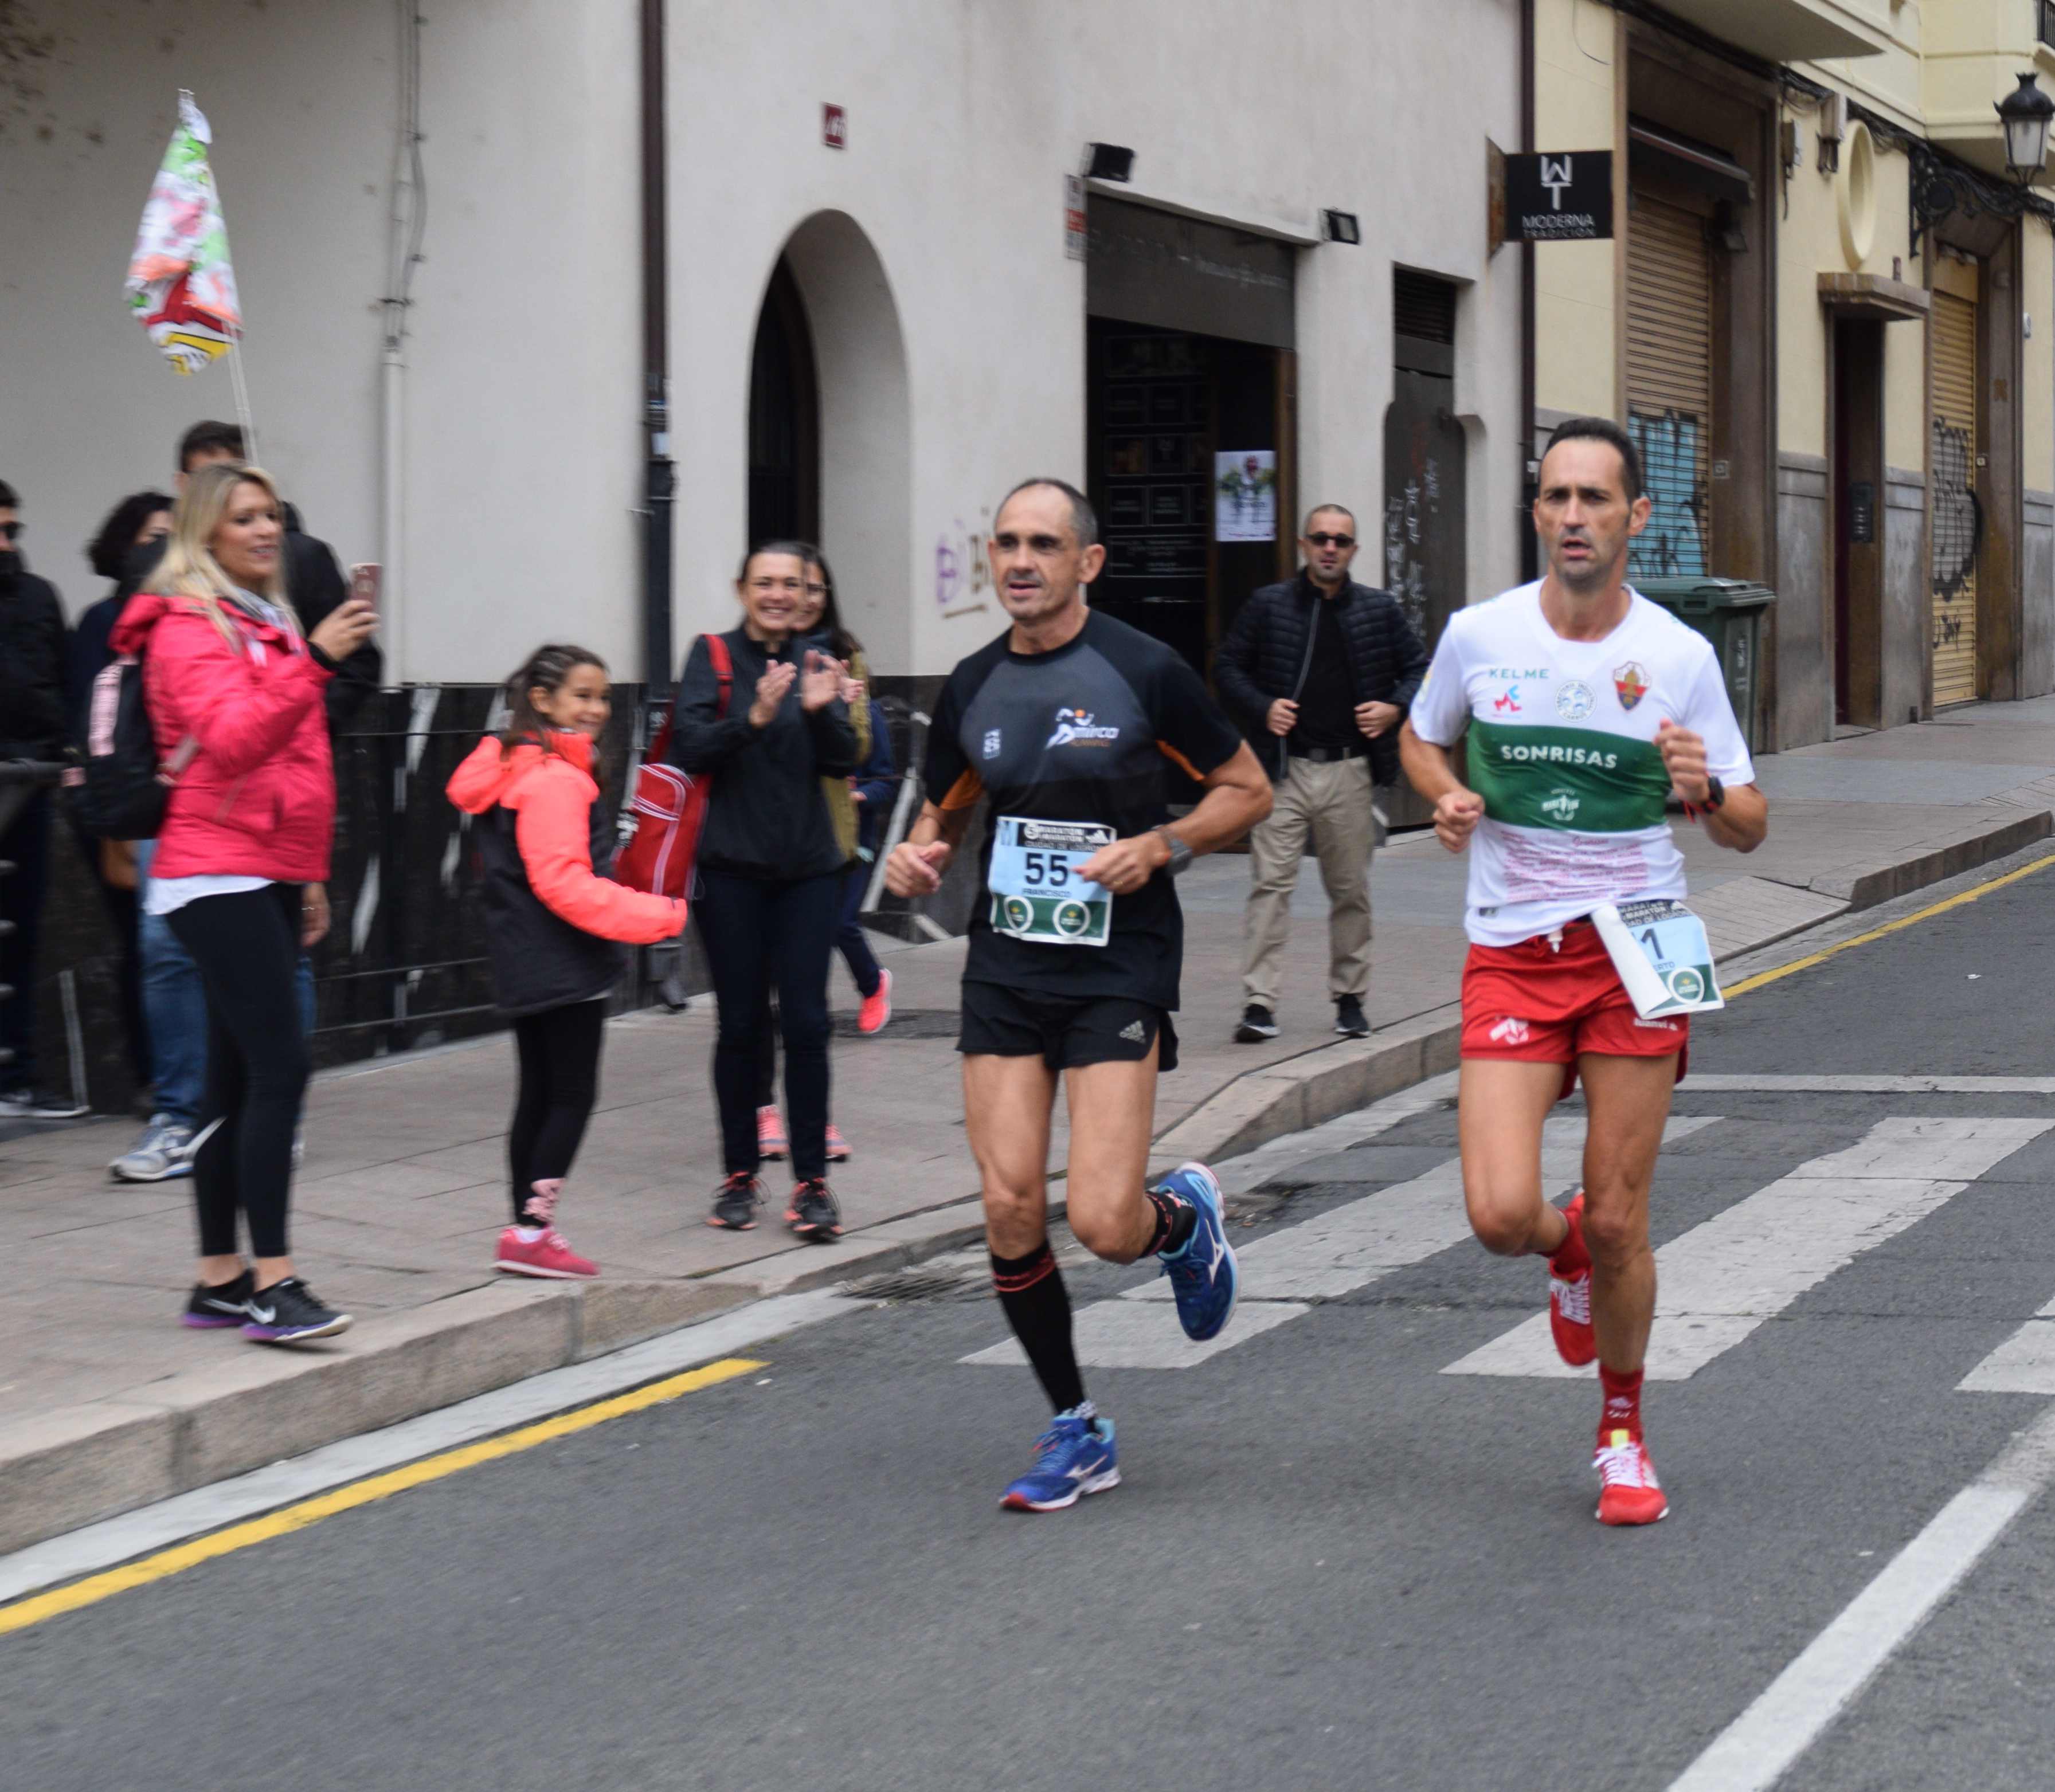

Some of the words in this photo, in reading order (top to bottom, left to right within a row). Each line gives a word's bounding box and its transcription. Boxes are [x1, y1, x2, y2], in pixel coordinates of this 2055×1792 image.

[1522, 213, 1595, 229] MODERNA
[1489, 668, 1550, 679] KELME
[1500, 744, 1618, 768] SONRISAS
[1024, 852, 1070, 888] 55
[1021, 888, 1072, 898] FRANCISCO
